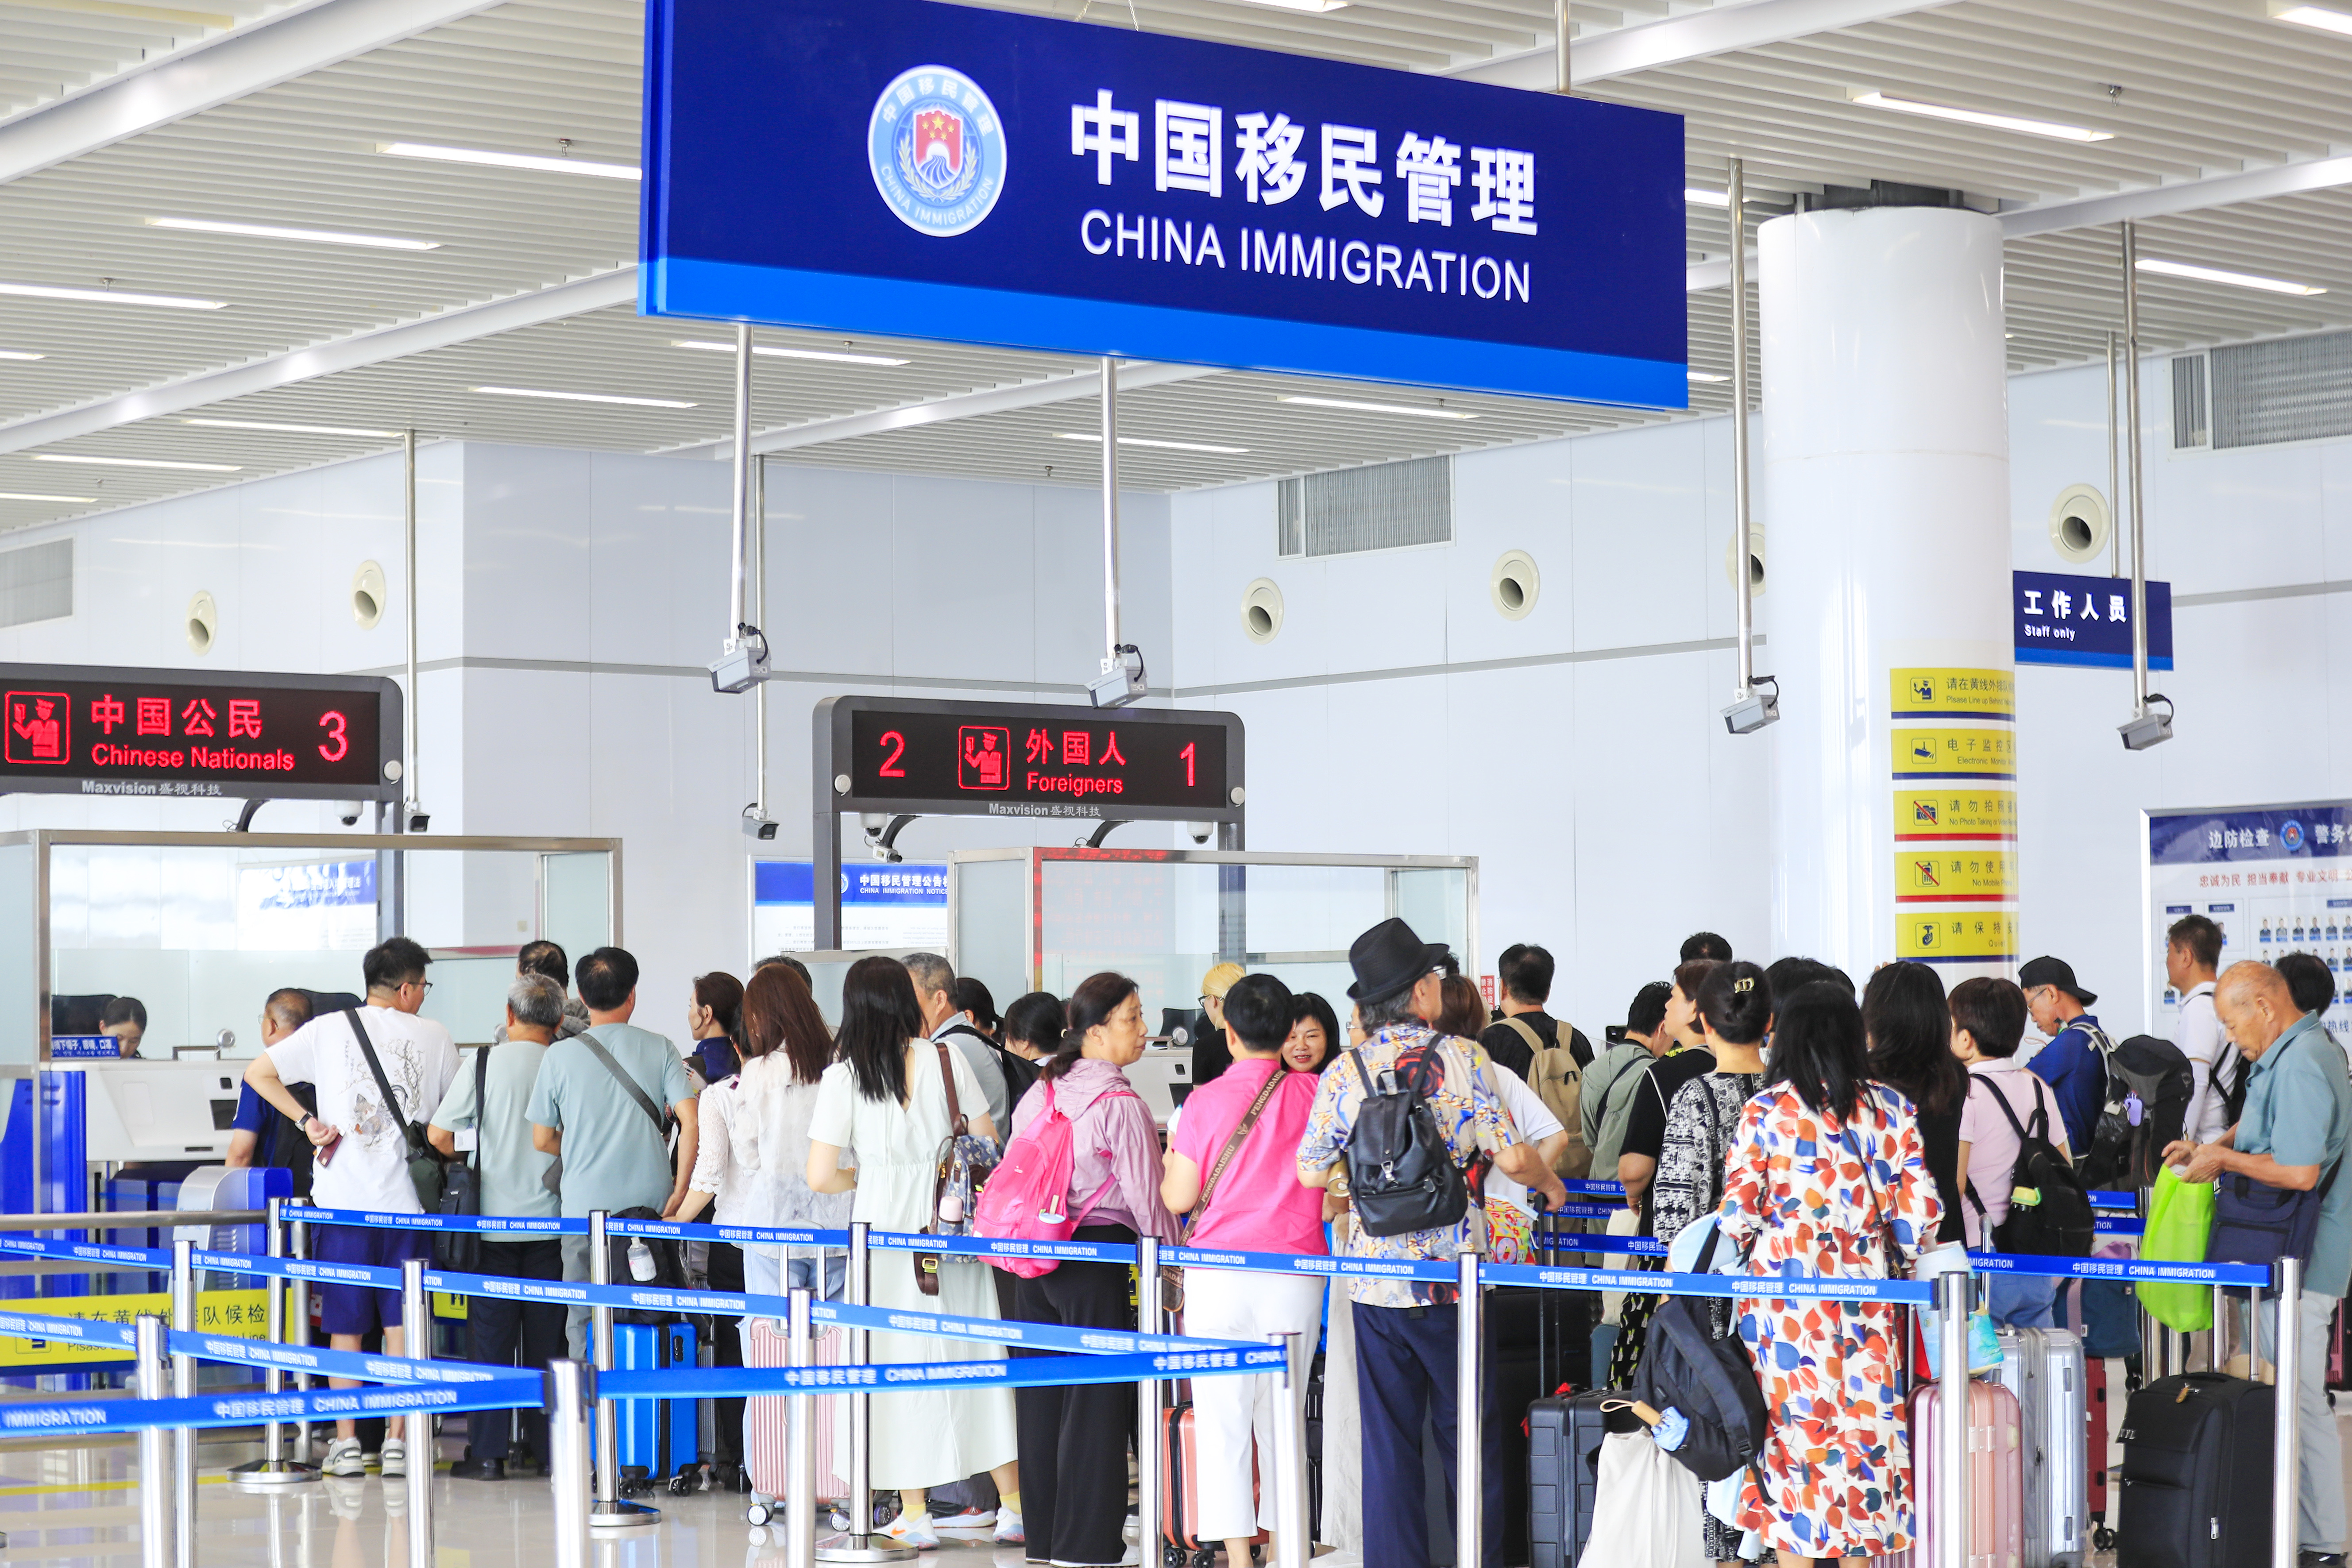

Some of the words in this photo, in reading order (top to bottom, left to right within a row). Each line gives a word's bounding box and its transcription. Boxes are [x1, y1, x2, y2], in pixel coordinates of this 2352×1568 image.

[1070, 88, 1538, 236] 中国移民管理
[881, 166, 911, 212] CHINA
[915, 178, 994, 226] IMMIGRATION
[1081, 209, 1226, 269] CHINA
[1241, 227, 1530, 304] IMMIGRATION
[2023, 589, 2127, 623] 工作人员
[2024, 623, 2051, 638] Staff
[2053, 626, 2076, 642] only
[1969, 696, 1981, 705] Line
[91, 694, 263, 740] 中国公民
[318, 710, 348, 763] 3
[1025, 728, 1126, 767] 外国人
[1948, 738, 2016, 753] 电子监控区
[91, 743, 184, 768] Chinese
[191, 746, 296, 771] Nationals
[879, 730, 905, 777] 2
[1180, 742, 1196, 787] 1
[1957, 757, 1988, 765] Electronic
[82, 780, 156, 796] Maxvision
[158, 782, 223, 797] 盛视科技
[1027, 772, 1124, 797] Foreigners
[989, 803, 1048, 816] Maxvision
[1050, 805, 1101, 818] 盛视科技
[2208, 827, 2270, 849] 边防检查
[2199, 873, 2241, 888] 忠诚为民
[2247, 871, 2289, 885] 担当奉献
[2296, 869, 2338, 883] 专业文明
[1952, 921, 2019, 935] 请保持安
[1201, 1144, 1235, 1203] PENGDADAISHU
[1585, 1183, 1616, 1192] 中国移民管理
[289, 1210, 303, 1218] CHINA
[304, 1211, 333, 1220] IMMIGRATION
[365, 1214, 393, 1225] 中国移民管理
[395, 1216, 410, 1226] CHINA
[411, 1217, 443, 1227] IMMIGRATION
[476, 1220, 507, 1230] 中国移民管理
[510, 1220, 525, 1230] CHINA
[526, 1221, 560, 1231] IMMIGRATION
[627, 1223, 644, 1233] CHINA
[645, 1224, 681, 1235] IMMIGRATION
[719, 1229, 753, 1240] 中国移民管理
[756, 1231, 775, 1241] CHINA
[776, 1232, 814, 1242] IMMIGRATION
[101, 1249, 116, 1259] CHINA
[117, 1251, 147, 1262] IMMIGRATION
[888, 1237, 907, 1247] CHINA
[908, 1238, 947, 1249] IMMIGRATION
[991, 1242, 1029, 1254] 中国移民管理
[1032, 1244, 1053, 1255] CHINA
[1054, 1245, 1097, 1256] IMMIGRATION
[204, 1255, 220, 1266] CHINA
[220, 1257, 252, 1269] IMMIGRATION
[285, 1263, 317, 1277] 中国移民管理
[319, 1266, 336, 1278] CHINA
[336, 1267, 371, 1281] IMMIGRATION
[1178, 1251, 1200, 1262] CHINA
[1201, 1253, 1245, 1265] IMMIGRATION
[1294, 1259, 1336, 1271] 中国移民管理
[1340, 1261, 1363, 1272] CHINA
[1364, 1263, 1414, 1275] IMMIGRATION
[1967, 1258, 2013, 1269] MIGRATION
[2072, 1262, 2124, 1276] 中国移民管理
[2128, 1265, 2155, 1277] CHINA
[2157, 1267, 2216, 1280] IMMIGRATION
[483, 1280, 521, 1295] 中国移民管理
[523, 1284, 545, 1297] CHINA
[545, 1286, 587, 1300] IMMIGRATION
[631, 1292, 673, 1307] 中国移民管理
[676, 1295, 699, 1308] CHINA
[700, 1296, 746, 1311] IMMIGRATION
[1538, 1271, 1587, 1285] 中国移民管理
[1591, 1274, 1617, 1286] CHINA
[1618, 1275, 1673, 1289] IMMIGRATION
[1731, 1280, 1784, 1295] 中国移民管理
[1788, 1283, 1816, 1295] CHINA
[1818, 1284, 1876, 1297] IMMIGRATION
[46, 1322, 83, 1337] IMMIGRATION
[940, 1320, 967, 1334] CHINA
[967, 1323, 1023, 1340] IMMIGRATION
[205, 1340, 247, 1359] 中国移民管理
[248, 1346, 271, 1362] CHINA
[273, 1348, 317, 1367] IMMIGRATION
[364, 1359, 412, 1379] 中国移民管理
[415, 1366, 440, 1382] CHINA
[784, 1368, 877, 1386] 中国移民管理
[884, 1367, 925, 1382] CHINA
[925, 1364, 1007, 1380] IMMIGRATION
[3, 1406, 107, 1429] IMMIGRATION
[213, 1396, 305, 1419] 中国移民管理
[313, 1394, 360, 1414] CHINA
[362, 1389, 457, 1410] IMMIGRATION
